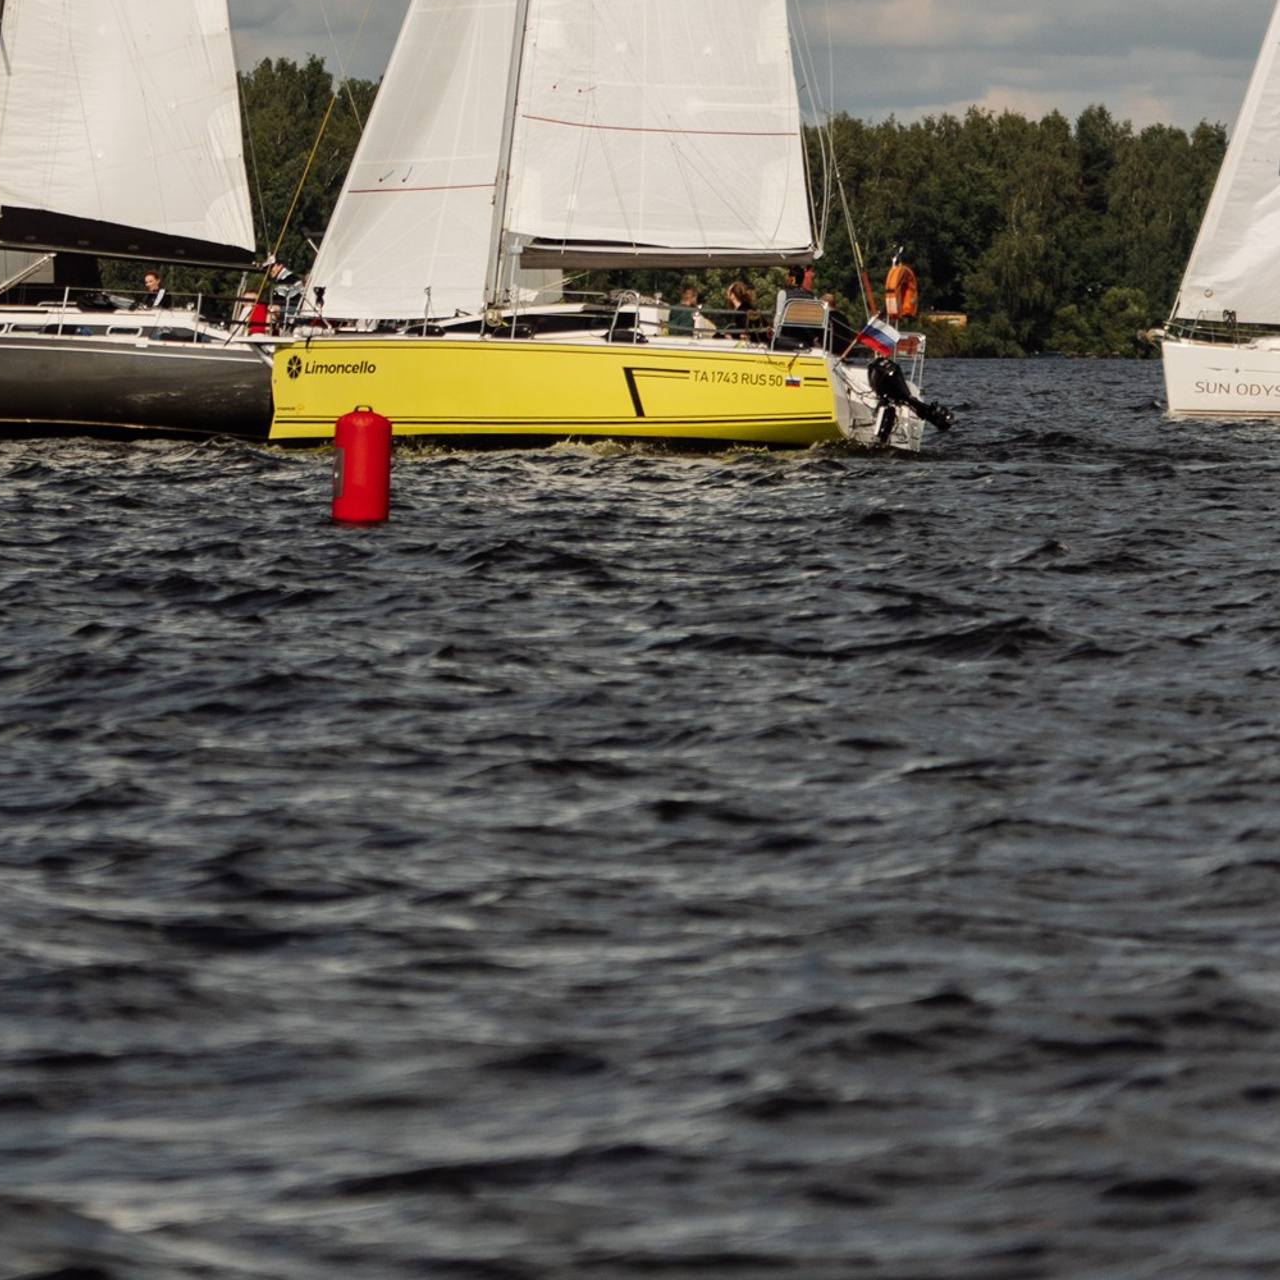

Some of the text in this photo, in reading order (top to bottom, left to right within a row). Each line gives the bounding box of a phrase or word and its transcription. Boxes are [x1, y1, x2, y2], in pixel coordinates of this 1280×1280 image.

[304, 360, 376, 374] Limoncello
[693, 370, 783, 387] TA 1743 RUS 50
[1194, 381, 1230, 394] SUN
